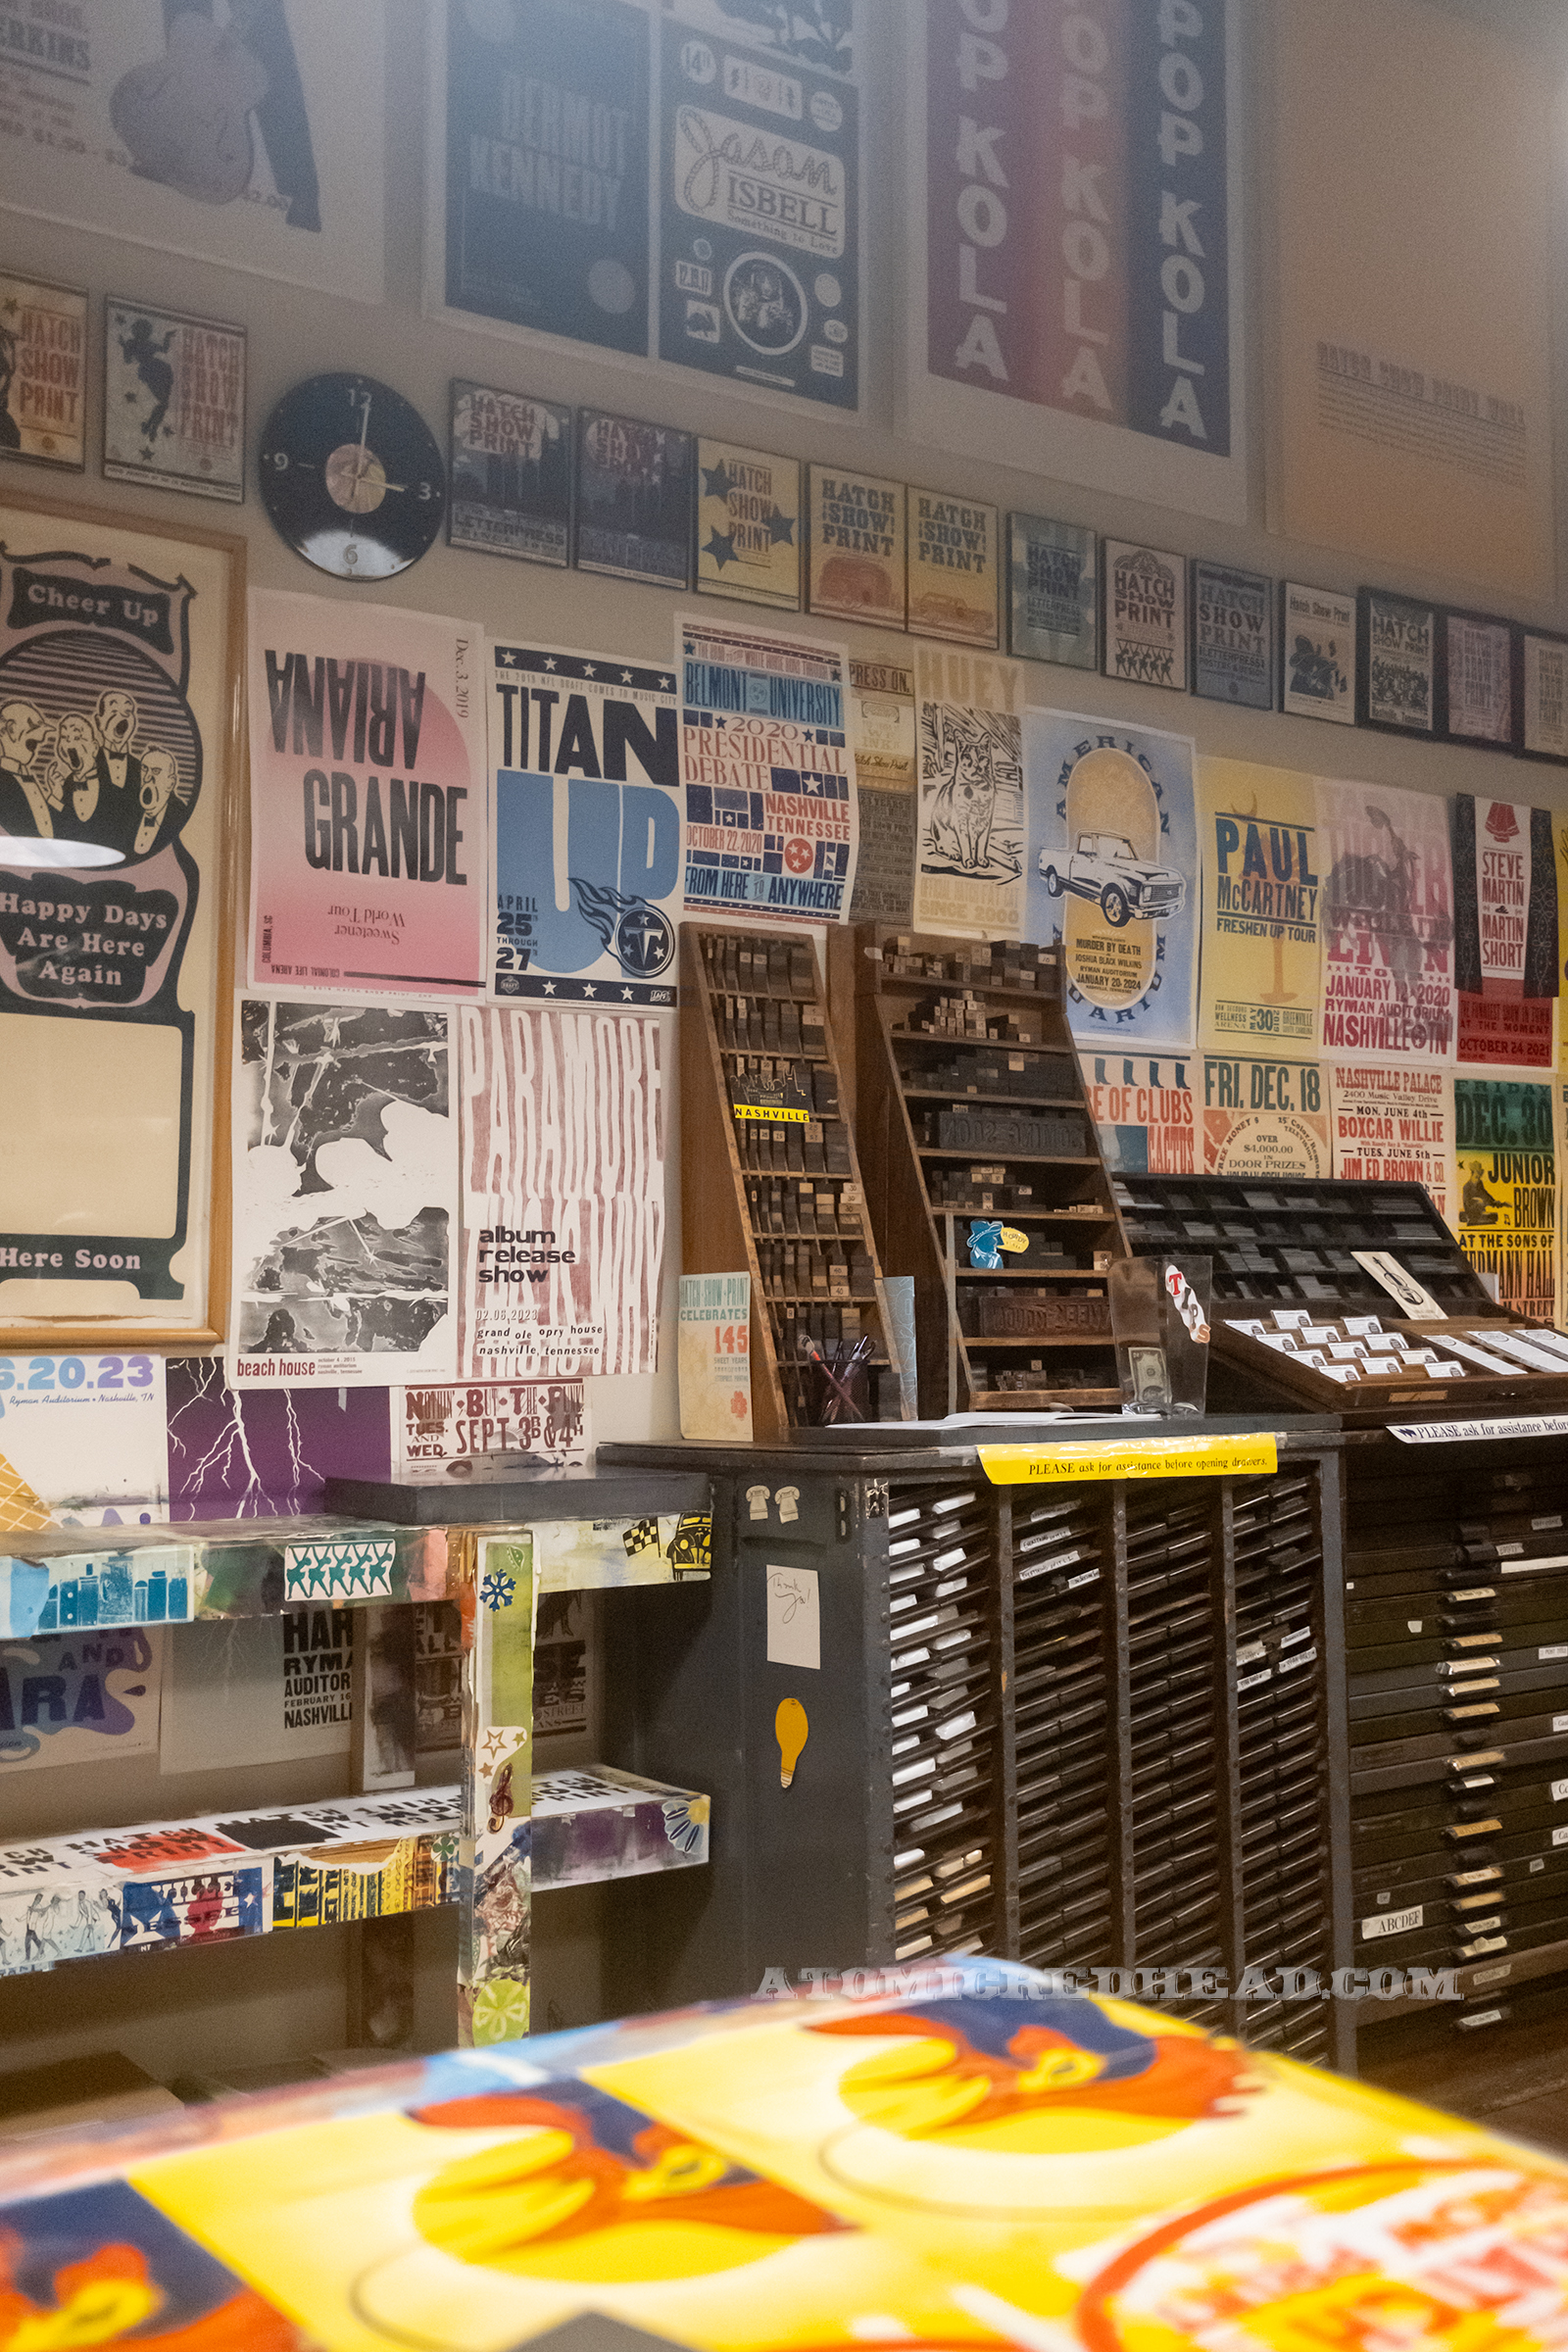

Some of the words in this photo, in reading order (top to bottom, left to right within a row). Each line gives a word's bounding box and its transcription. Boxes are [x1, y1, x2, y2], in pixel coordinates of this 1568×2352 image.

[726, 175, 838, 235] ISBELL
[810, 235, 840, 256] Love
[956, 115, 1010, 382] KOLA
[1060, 155, 1114, 413] KOLA
[1158, 190, 1208, 440] KOLA
[20, 310, 82, 354] HATCH
[20, 348, 79, 388] SHOW
[19, 380, 78, 424] PRINT
[470, 394, 536, 424] HATCH
[470, 415, 534, 440] SHOW
[469, 430, 535, 458] PRINT
[274, 453, 289, 471] 9
[418, 482, 434, 501] 3
[728, 465, 772, 498] HATCH
[727, 492, 771, 522] SHOW
[822, 477, 895, 515] HATCH
[918, 496, 986, 532] HATCH
[343, 543, 358, 564] 6
[822, 522, 894, 557] PRINT
[918, 540, 986, 574] PRINT
[1114, 569, 1175, 600] HATCH
[1115, 588, 1174, 610] SHOW
[1200, 582, 1264, 614] HATCH
[28, 584, 111, 615] Cheer
[123, 599, 159, 627] Up
[1114, 600, 1175, 629] PRINT
[1199, 602, 1264, 633] SHOW
[1200, 622, 1264, 655] PRINT
[1371, 615, 1430, 645] HATCH
[561, 678, 584, 692] DRAFT
[589, 682, 614, 697] COMES
[632, 690, 657, 704] MUSIC
[686, 662, 748, 712] BELMONT
[769, 675, 840, 727] UNIVERSITY
[917, 648, 1019, 713] HUEY
[265, 649, 426, 770] ARIANA
[496, 683, 680, 788] TITAN
[731, 716, 799, 741] 2020
[683, 726, 848, 774] PRESIDENTIAL
[684, 754, 769, 791] DEBATE
[1056, 736, 1170, 836] AMERICAN
[765, 793, 851, 824] NASHVILLE
[303, 769, 468, 886] GRANDE
[686, 825, 725, 851] OCTOBER
[740, 833, 762, 855] 2020
[765, 815, 851, 841] TENNESSEE
[1215, 817, 1318, 888] PAUL
[1482, 851, 1524, 881] STEVE
[497, 769, 680, 977] UP
[685, 866, 718, 897] FROM
[720, 869, 750, 900] HERE
[768, 876, 845, 911] ANYWHERE
[1217, 874, 1318, 921] McCARTNEY
[1482, 877, 1524, 906] MARTIN
[0, 892, 91, 923] Happy
[104, 905, 168, 931] Days
[497, 894, 539, 913] APRIL
[973, 905, 1020, 924] 2000
[17, 926, 69, 950] Are
[81, 932, 145, 956] Here
[334, 924, 401, 946] Sweetener
[496, 936, 539, 947] THROUGH
[1216, 917, 1268, 938] FRESHEN
[1288, 927, 1316, 943] TOUR
[1482, 913, 1524, 943] MARTIN
[1076, 939, 1105, 952] MURDER
[1118, 944, 1142, 956] DEATH
[1482, 940, 1524, 969] SHORT
[38, 960, 122, 986] Again
[310, 966, 340, 979] COLONIAL
[1076, 973, 1109, 986] JANUARY
[1102, 968, 1138, 978] AUDITORIUM
[1326, 975, 1391, 1002] JANUARY
[1417, 983, 1450, 1007] 2020
[1215, 1011, 1247, 1022] WELLNESS
[1256, 1008, 1273, 1031] 30
[1325, 998, 1375, 1015] RYMAN
[1378, 1004, 1449, 1022] AUDITORIUM
[1323, 1012, 1410, 1052] NASHVILLE
[1478, 1020, 1497, 1031] THE
[1503, 1023, 1549, 1035] MOMENT
[1459, 1038, 1508, 1054] OCTOBER
[1526, 1043, 1549, 1057] 2021
[1203, 1060, 1245, 1108] FRI.
[1250, 1064, 1296, 1112] DEC.
[1299, 1066, 1321, 1113] 18
[1335, 1066, 1400, 1092] NASHVILLE
[1402, 1071, 1443, 1095] PALACE
[1455, 1079, 1551, 1096] FRIDAY
[460, 1005, 664, 1200] PARAMORE
[735, 1107, 808, 1122] NASHVILLE
[1108, 1087, 1132, 1123] OF
[1136, 1088, 1193, 1125] CLUBS
[1356, 1105, 1381, 1115] MON.
[1384, 1107, 1409, 1117] JUNE
[1412, 1108, 1428, 1118] 4th
[1338, 1115, 1394, 1140] BOXCAR
[1398, 1118, 1445, 1143] WILLIE
[1455, 1093, 1517, 1146] DEC.
[1523, 1096, 1552, 1146] 30
[1147, 1125, 1195, 1174] CACTUS
[1256, 1135, 1279, 1144] OVER
[1357, 1148, 1384, 1157] TUES.
[1387, 1149, 1412, 1158] JUNE
[1415, 1150, 1431, 1159] 5th
[1228, 1158, 1263, 1169] DOOR
[1265, 1159, 1306, 1170] PRIZES
[1341, 1158, 1363, 1180] JIM
[1383, 1159, 1423, 1182] BROWN
[1487, 1152, 1555, 1185] JUNIOR
[1513, 1187, 1555, 1229] BROWN
[479, 1225, 557, 1244] album
[1458, 1234, 1476, 1249] AT
[1479, 1235, 1503, 1248] THE
[1506, 1235, 1538, 1249] SONS
[1540, 1235, 1555, 1249] OF
[0, 1247, 64, 1269] Here
[74, 1249, 141, 1270] Soon
[478, 1246, 576, 1264] release
[478, 1265, 549, 1284] show
[726, 1277, 748, 1306] PRINT
[680, 1308, 748, 1321] CELEBRATES
[476, 1327, 511, 1339] grand
[539, 1328, 564, 1339] opry
[570, 1324, 604, 1335] house
[714, 1325, 749, 1354] 145
[479, 1345, 540, 1357] nashville,
[544, 1347, 600, 1356] tennessee
[236, 1358, 274, 1377] beach
[279, 1358, 316, 1377] house
[42, 1394, 90, 1404] Auditorium
[405, 1421, 449, 1436] TUES.
[456, 1418, 514, 1454] SEPT.
[412, 1435, 439, 1444] AND
[1415, 1424, 1462, 1440] PLEASE
[1462, 1423, 1480, 1437] ask
[1481, 1422, 1495, 1436] for
[1498, 1421, 1543, 1435] assistance
[1029, 1462, 1076, 1476] PLEASE
[1079, 1461, 1095, 1473] ask
[1098, 1460, 1112, 1475] for
[1115, 1459, 1162, 1472] assistance
[1164, 1457, 1193, 1471] before
[1195, 1456, 1229, 1470] opening
[1231, 1455, 1268, 1468] drawers.
[284, 1695, 337, 1708] FEBRUARY
[66, 1827, 203, 1852] HATCH
[78, 1832, 211, 1860] SHOW
[1378, 1910, 1421, 1934] ABCDEF
